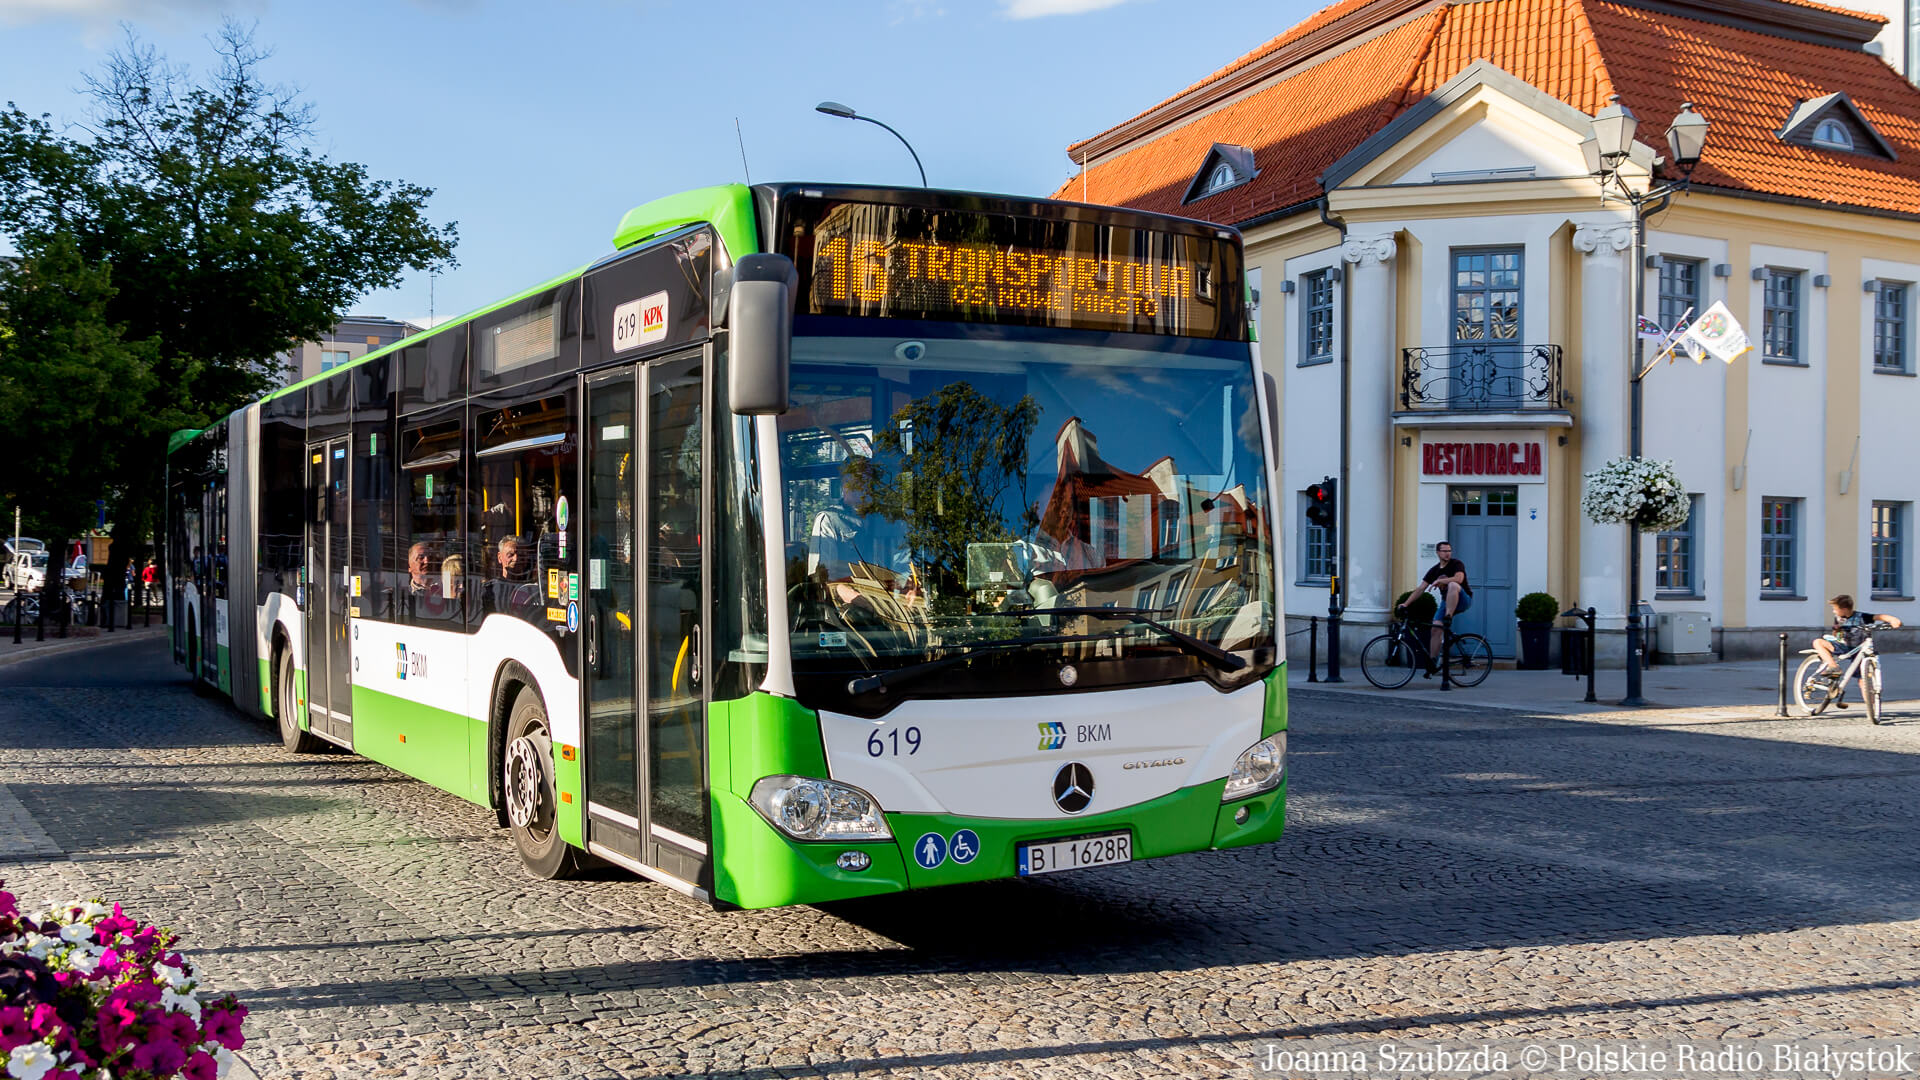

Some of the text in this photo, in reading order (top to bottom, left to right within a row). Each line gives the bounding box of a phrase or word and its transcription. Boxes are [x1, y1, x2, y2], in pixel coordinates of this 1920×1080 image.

[818, 237, 888, 302] 16
[902, 243, 1190, 298] TRANSPORTOWA
[643, 304, 664, 327] KPK
[952, 284, 1159, 316] OS. NOWE MIASTO
[617, 313, 636, 341] 619
[1422, 442, 1541, 475] RESTAURACJA
[411, 652, 428, 679] BKM
[867, 726, 922, 758] 619
[1077, 723, 1112, 743] BKM
[1122, 757, 1187, 769] CITARO
[1031, 846, 1056, 872] BI
[1070, 837, 1129, 866] 1628R
